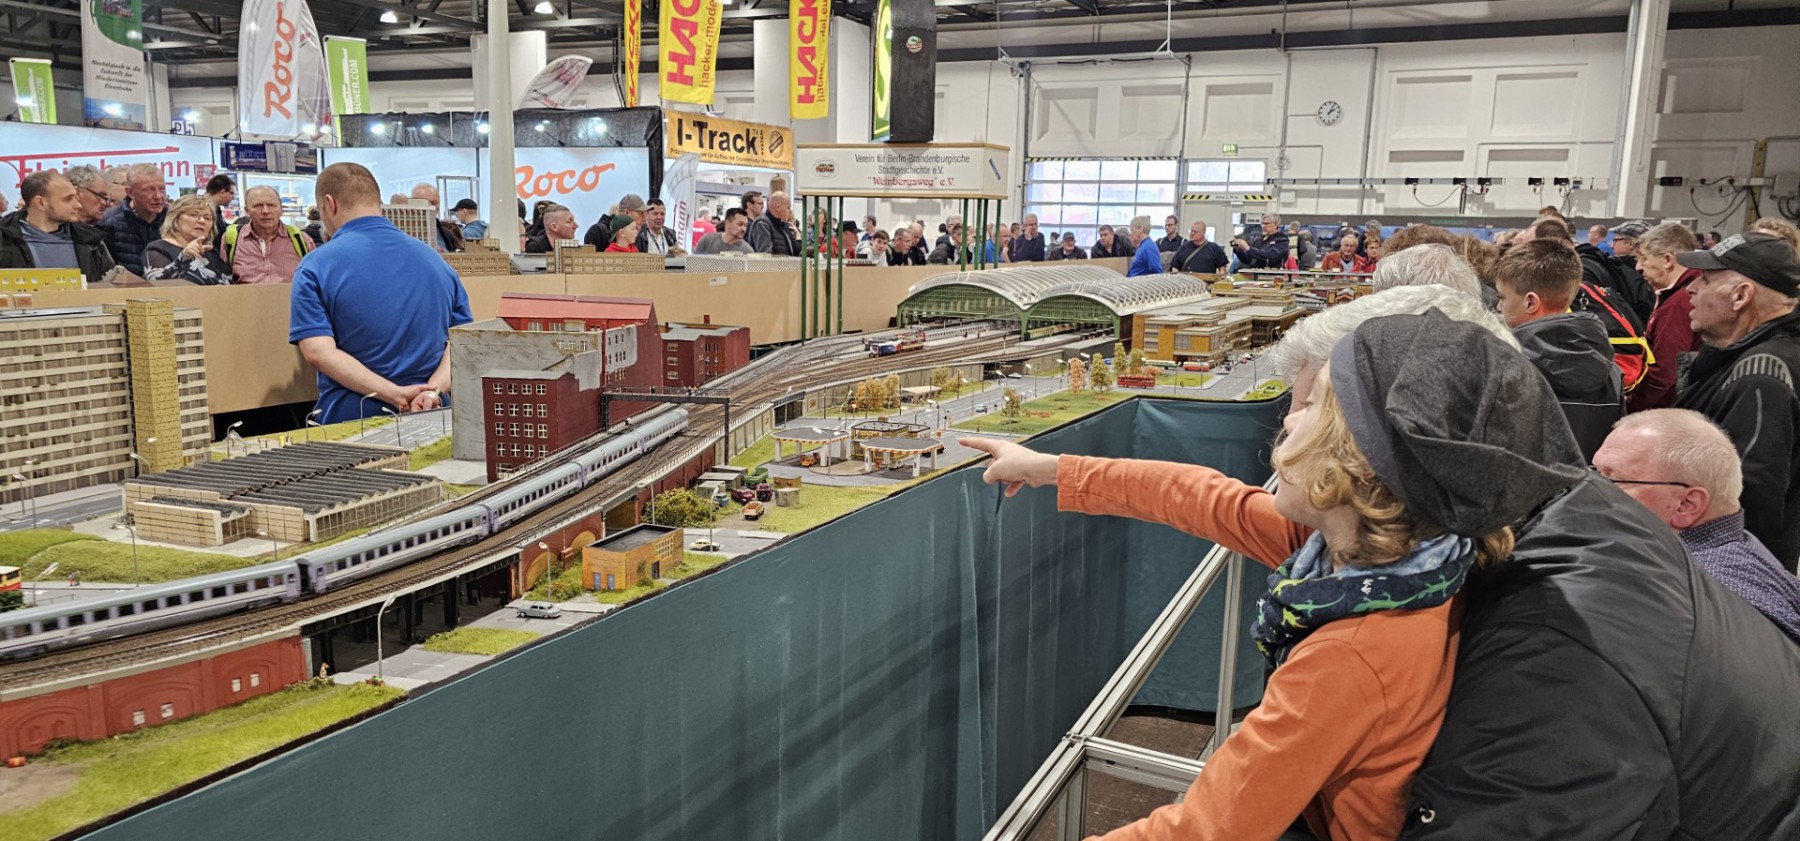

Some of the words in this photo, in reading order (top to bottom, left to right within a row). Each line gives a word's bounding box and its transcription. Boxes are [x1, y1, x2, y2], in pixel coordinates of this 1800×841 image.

[263, 2, 296, 119] Roco
[677, 118, 758, 155] I-Track
[854, 153, 875, 163] Verein
[876, 153, 886, 163] für
[887, 153, 970, 165] Berlin-Brandenburgische
[878, 165, 931, 176] Stadtgeschichte
[932, 165, 944, 175] e.V.
[515, 163, 616, 199] Roco
